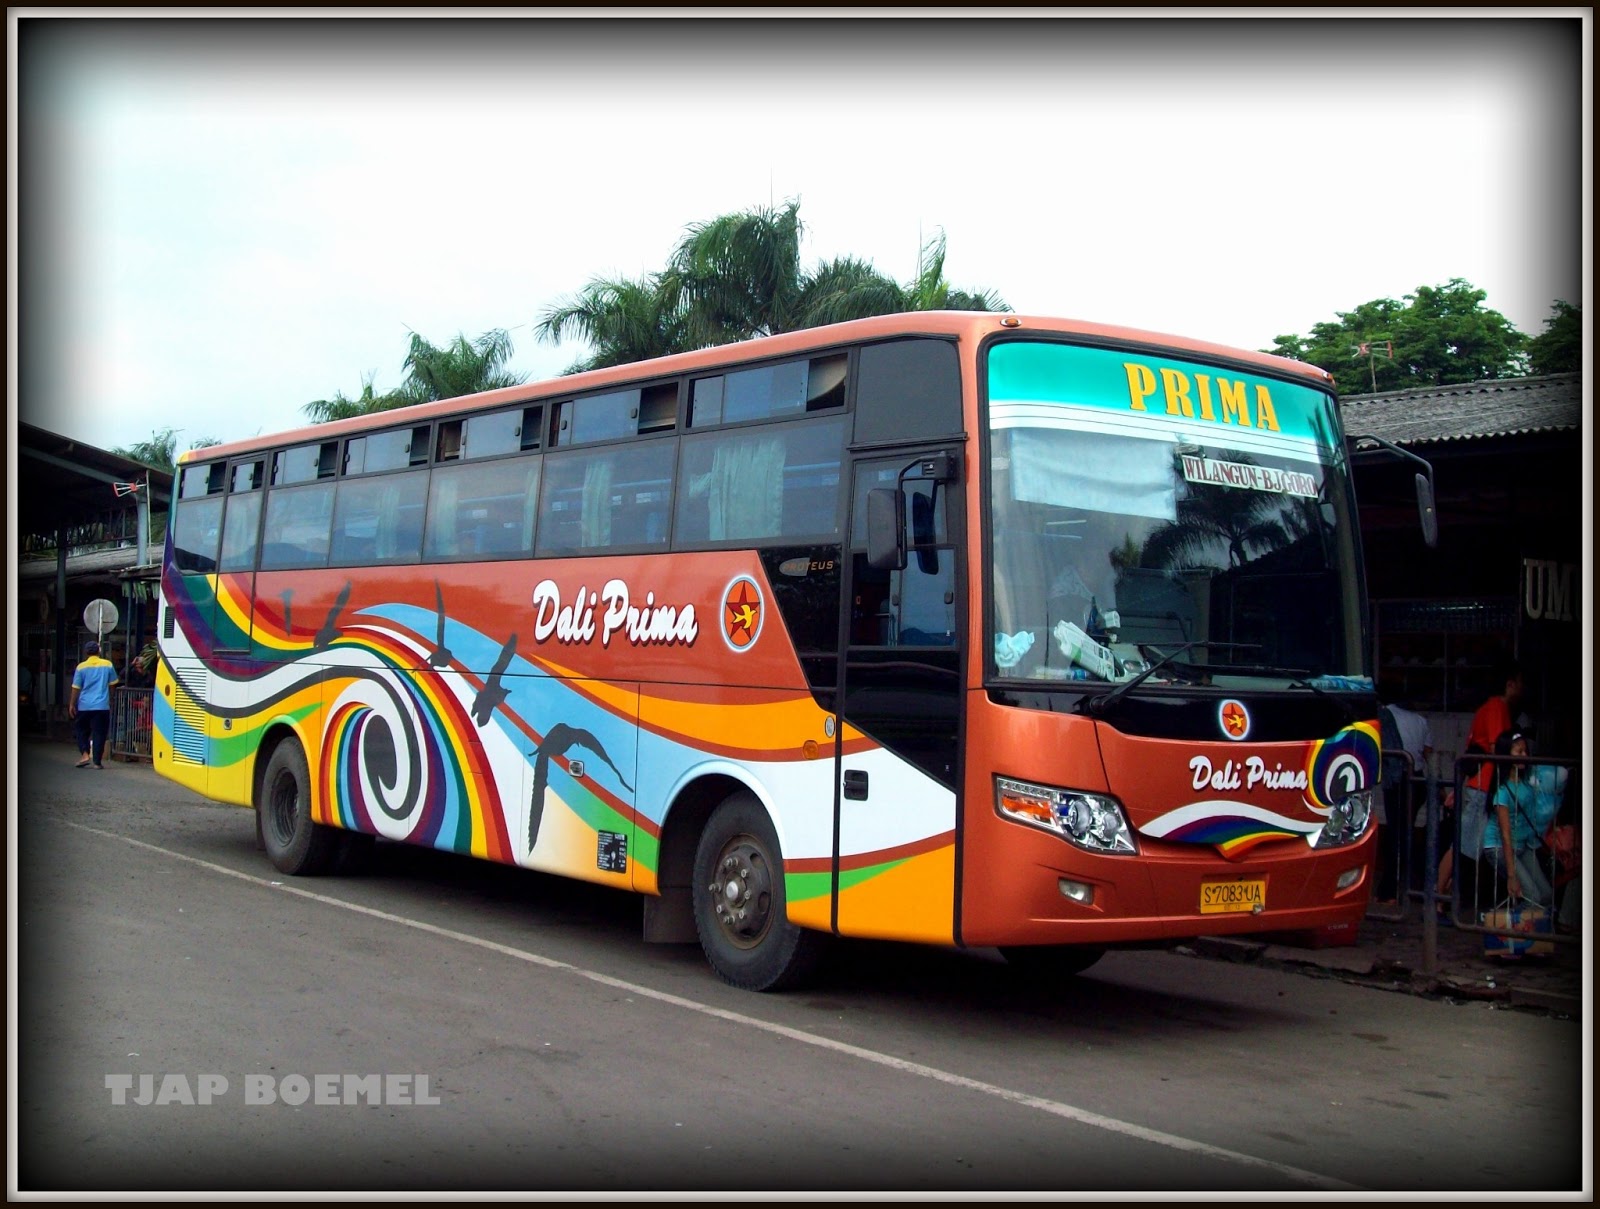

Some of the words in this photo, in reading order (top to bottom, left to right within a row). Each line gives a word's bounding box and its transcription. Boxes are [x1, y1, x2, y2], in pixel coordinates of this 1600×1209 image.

[1123, 362, 1280, 431] PRIMA
[533, 578, 597, 644] Dali
[601, 578, 698, 646] Prima
[1189, 755, 1241, 791] Dali
[1246, 756, 1308, 791] Prima
[1204, 886, 1212, 904] S
[1215, 885, 1243, 903] 7083
[1246, 884, 1261, 902] UA
